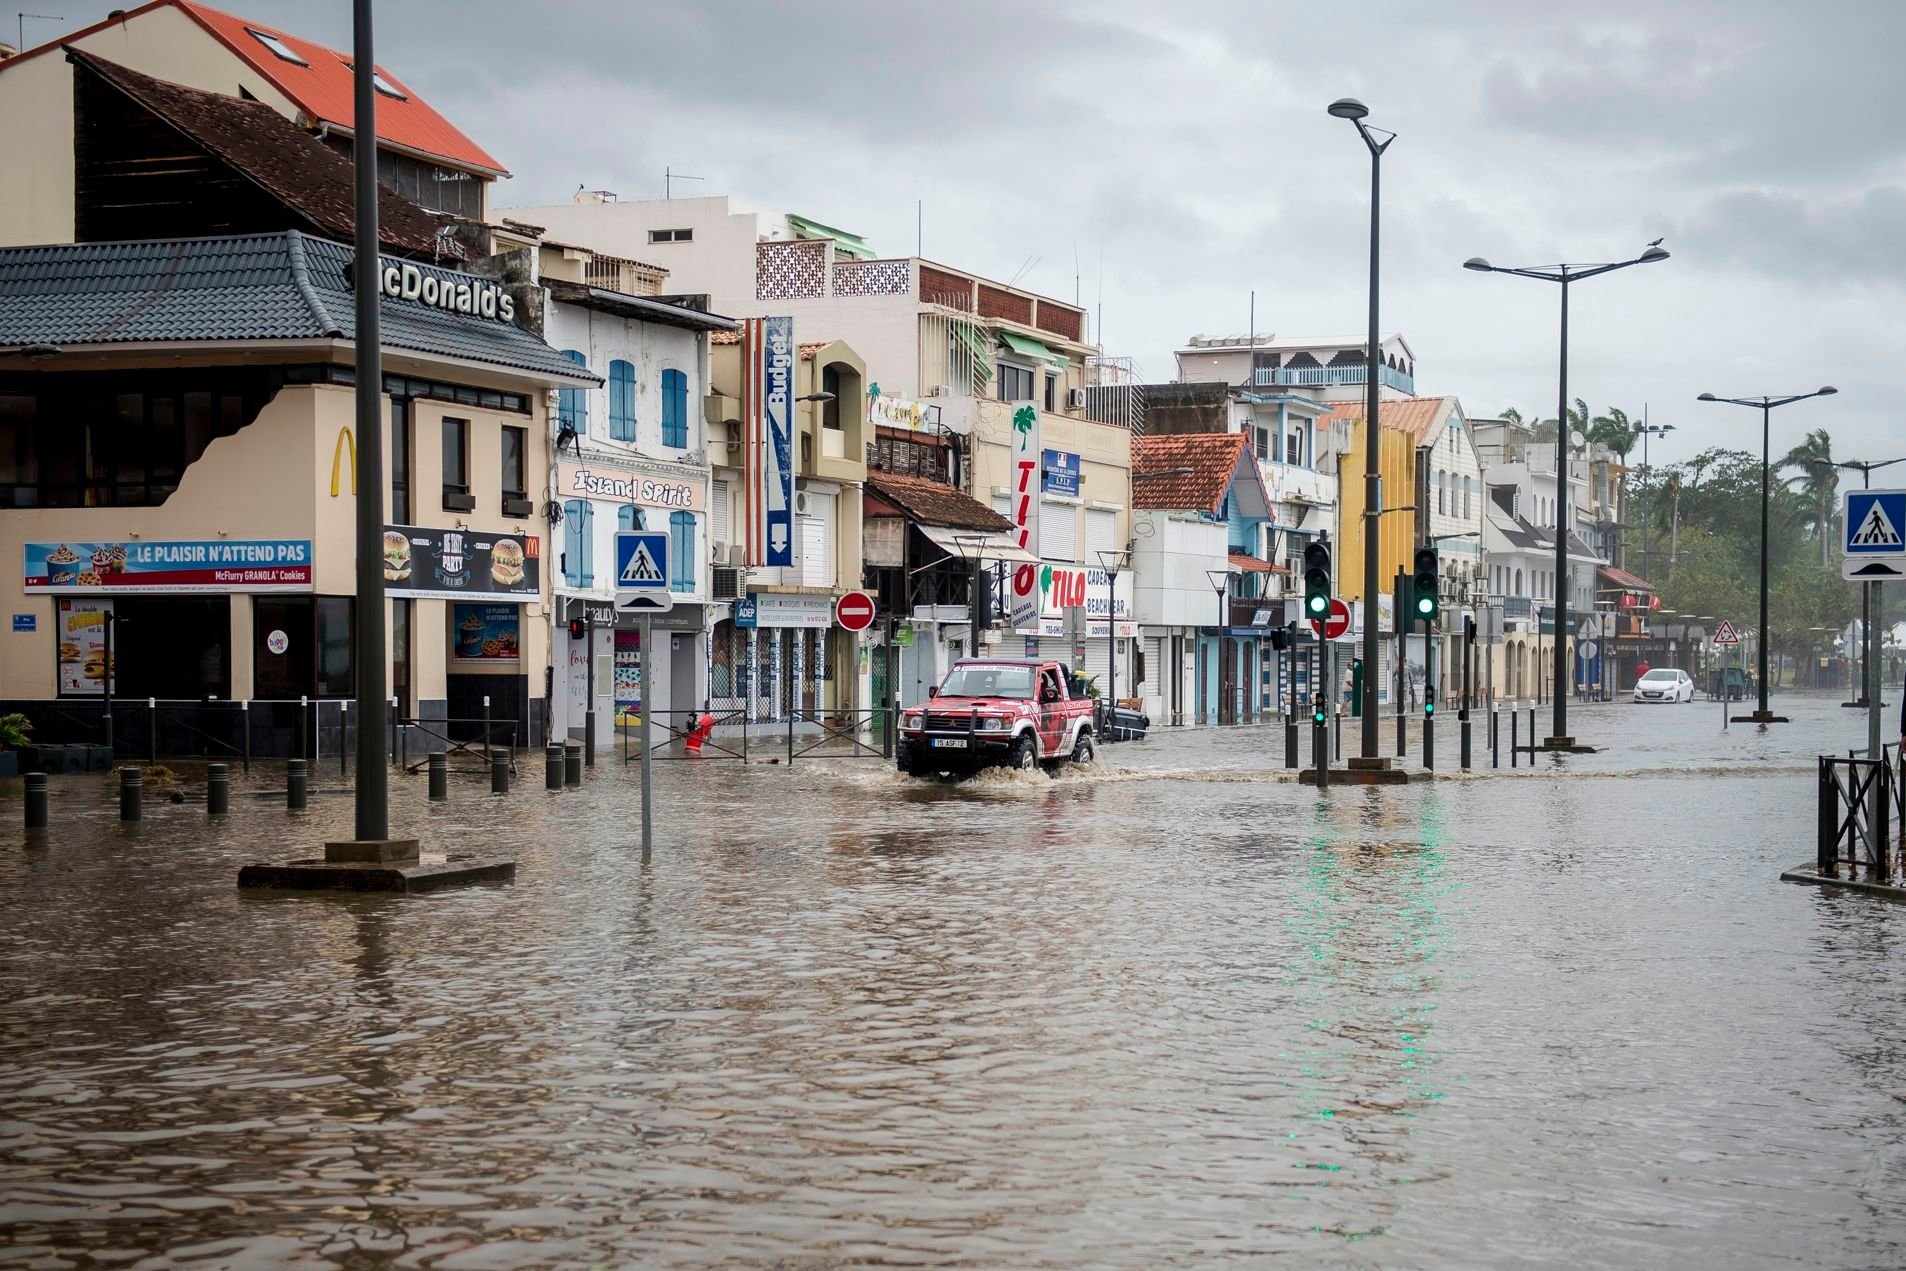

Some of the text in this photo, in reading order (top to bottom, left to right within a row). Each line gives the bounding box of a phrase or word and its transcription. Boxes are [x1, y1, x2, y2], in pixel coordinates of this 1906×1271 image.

[768, 334, 792, 406] Budget
[574, 471, 692, 506] Island Spirit
[137, 545, 304, 562] LE PLAISIR N'ATTEND PAS
[215, 571, 244, 582] McFlurry
[280, 570, 305, 580] Cookies
[1087, 570, 1113, 586] CADEA
[1052, 571, 1086, 608] TILO
[739, 608, 755, 617] ADEP
[1092, 626, 1110, 635] SOUVENI
